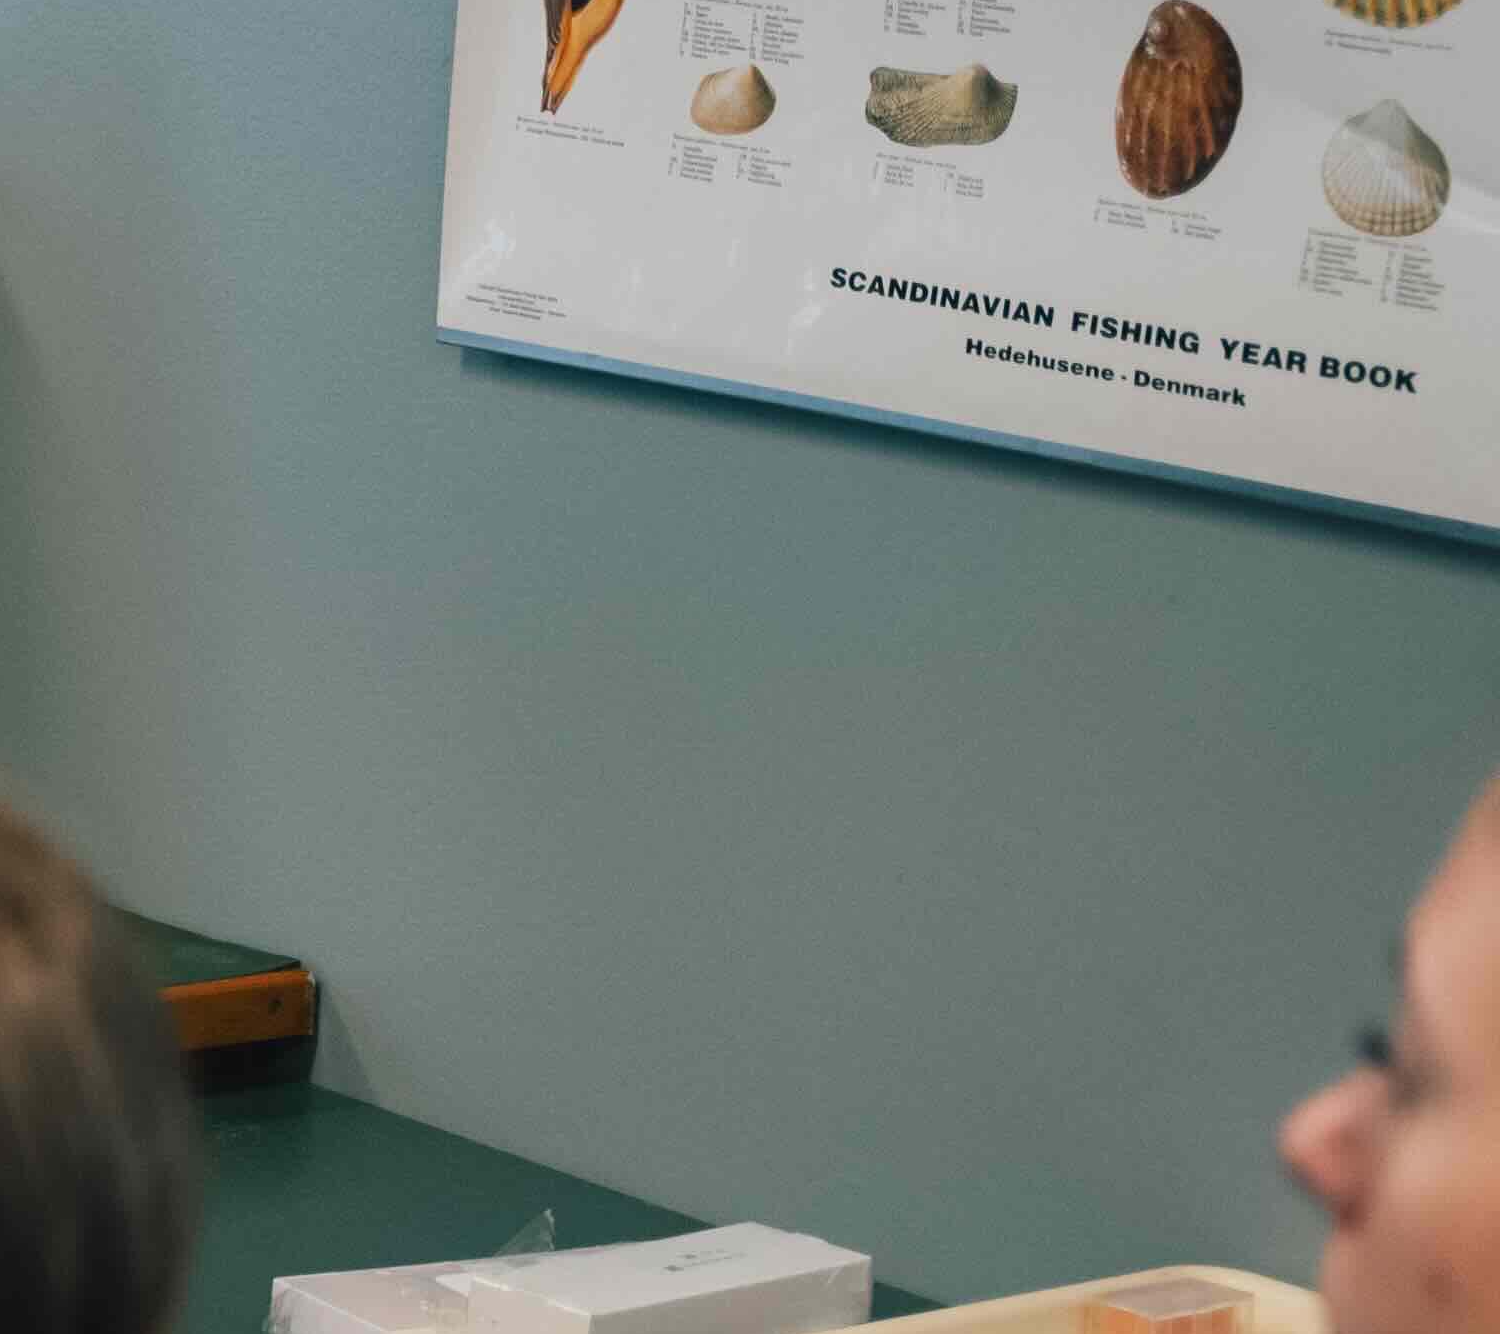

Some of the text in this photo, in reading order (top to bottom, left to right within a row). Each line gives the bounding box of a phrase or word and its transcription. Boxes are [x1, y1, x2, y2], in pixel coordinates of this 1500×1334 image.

[830, 267, 1418, 394] SCANDINAVIAN FISHING YEAR BOOK
[965, 338, 1116, 381] Hedehusene
[1133, 370, 1246, 407] Denmark
